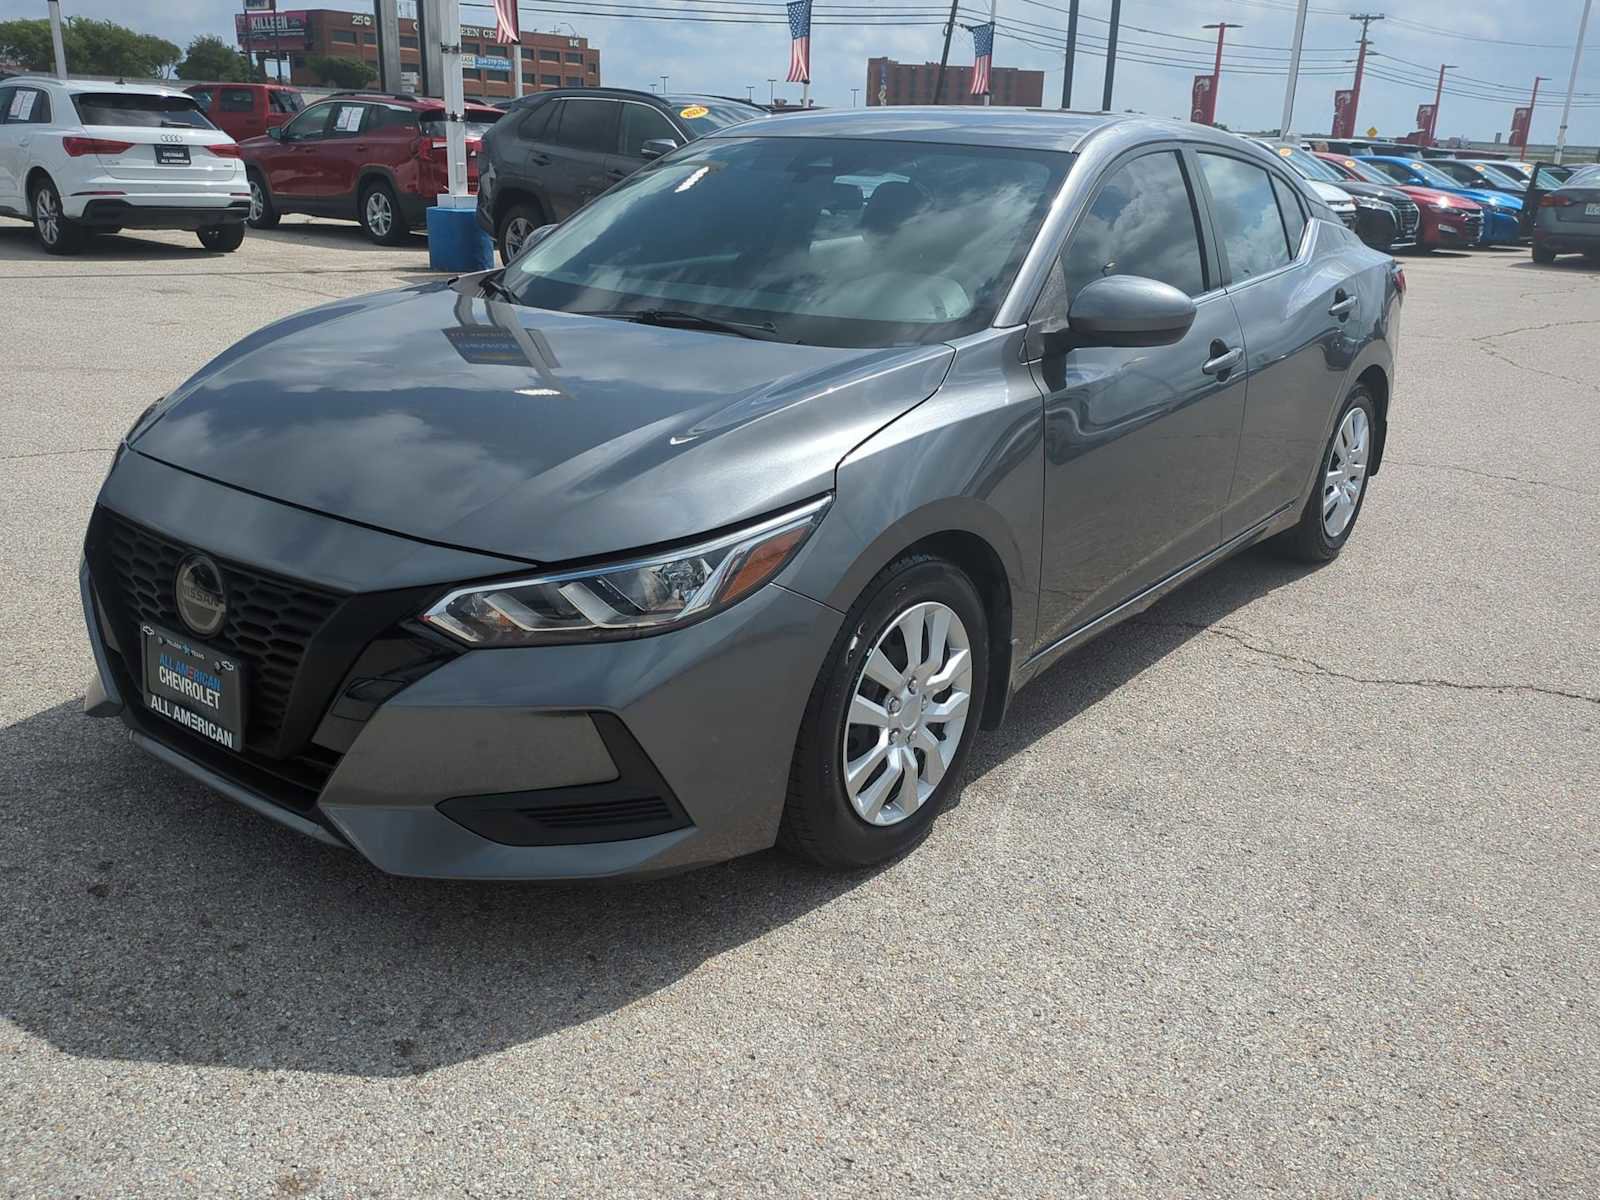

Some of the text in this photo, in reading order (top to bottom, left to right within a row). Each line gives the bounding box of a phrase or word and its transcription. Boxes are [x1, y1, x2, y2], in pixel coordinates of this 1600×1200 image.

[159, 666, 221, 709] CHEVROLET
[160, 655, 221, 691] ALL AMERICAN
[150, 695, 233, 748] ALL AMERICAN
